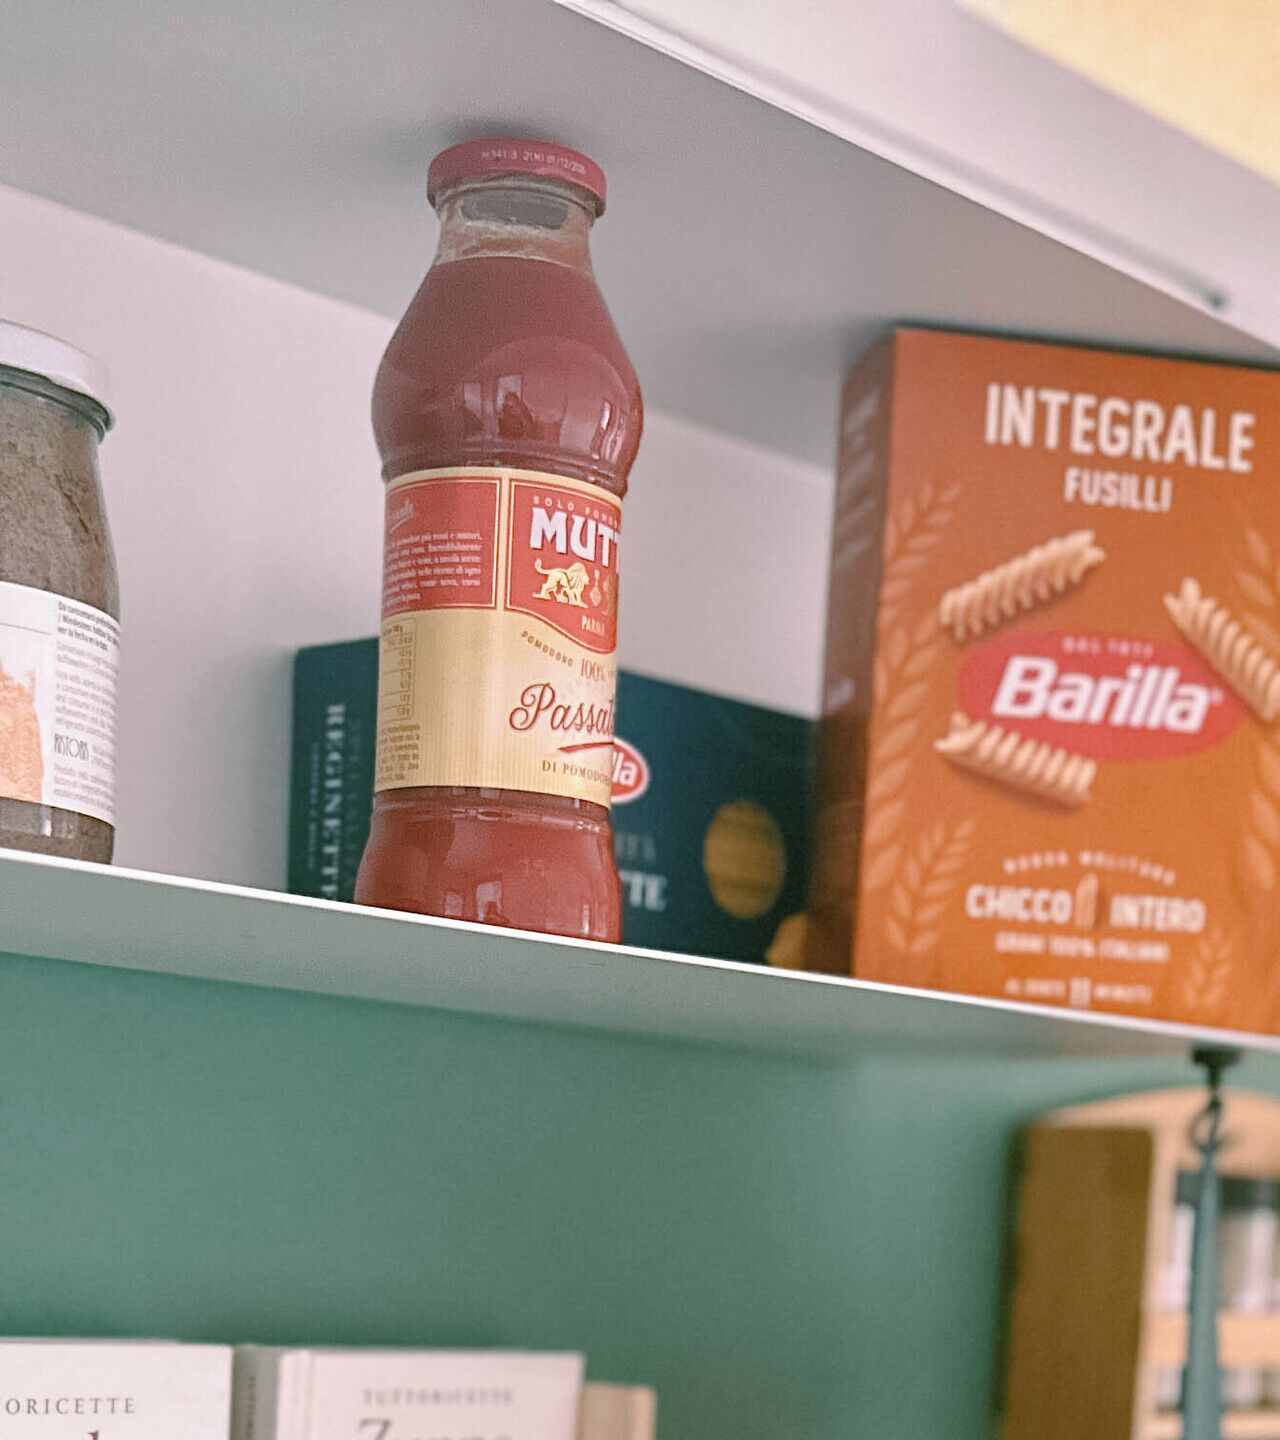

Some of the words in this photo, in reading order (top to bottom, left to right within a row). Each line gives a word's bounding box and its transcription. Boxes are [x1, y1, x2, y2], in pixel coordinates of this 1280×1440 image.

[984, 382, 1256, 473] INTEGRALE
[533, 495, 575, 511] SOLO
[1063, 466, 1173, 513] FUSILLI
[521, 630, 574, 667] POMODORO
[992, 654, 1213, 734] Barilla
[541, 760, 557, 772] DI
[965, 883, 1073, 925] CHICCO
[1109, 894, 1207, 934] INTERO
